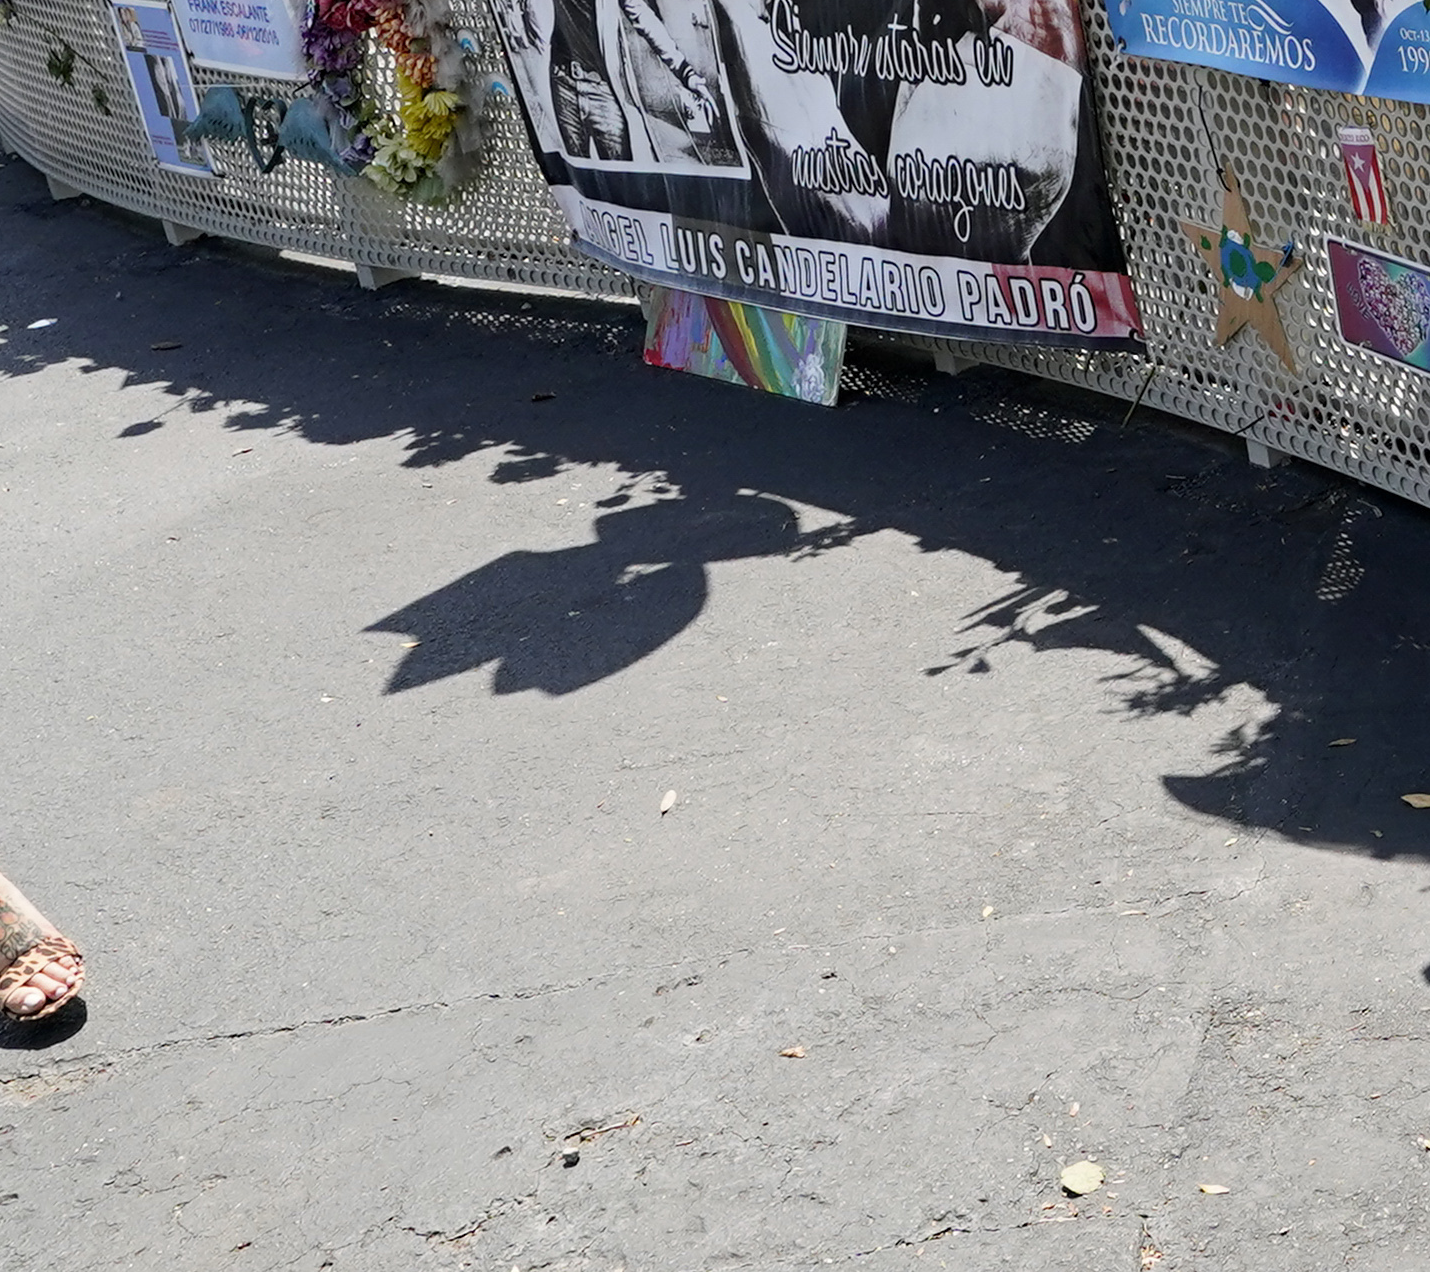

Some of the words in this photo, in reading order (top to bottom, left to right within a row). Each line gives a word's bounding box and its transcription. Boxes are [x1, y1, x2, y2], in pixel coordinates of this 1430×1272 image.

[221, 0, 270, 23] ESCALANTE
[1227, 0, 1247, 26] TE
[1399, 28, 1430, 43] OCT-13
[972, 34, 1014, 86] en
[1141, 13, 1317, 73] RECORDAREMOS
[791, 127, 891, 200] nuestros
[893, 147, 1026, 243] corazones
[579, 203, 654, 266] ANGEL
[665, 226, 727, 281] LUIS
[736, 236, 946, 319] CANDELARIO
[958, 270, 1098, 333] PADRÓ
